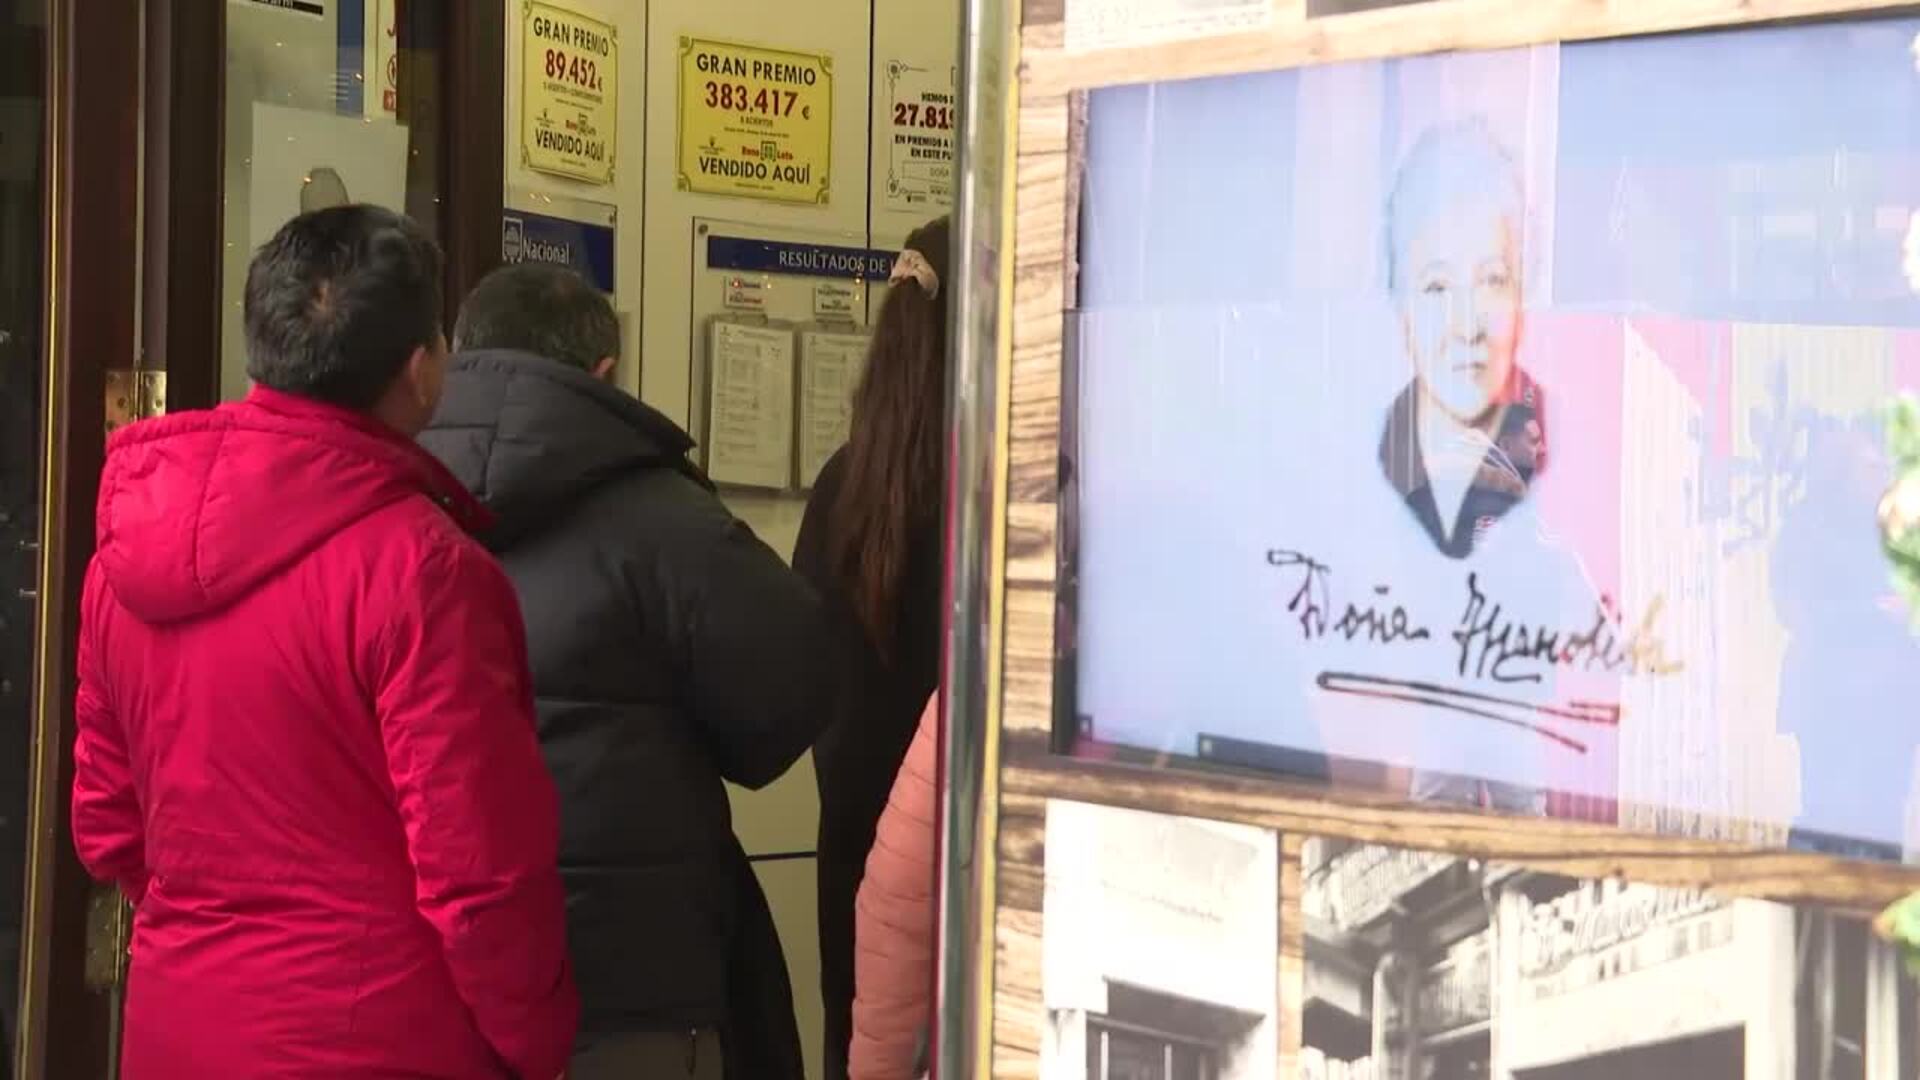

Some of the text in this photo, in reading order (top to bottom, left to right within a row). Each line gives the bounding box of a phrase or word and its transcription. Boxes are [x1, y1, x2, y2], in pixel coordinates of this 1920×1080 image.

[533, 16, 609, 57] GRAN PREMIO
[696, 53, 817, 86] GRAN PREMIO
[705, 80, 799, 118] 383.417
[535, 127, 583, 156] VENDIDO
[895, 133, 906, 145] EN
[907, 135, 942, 148] PREMIOS
[910, 147, 921, 159] EN
[922, 149, 941, 161] ESTE
[698, 155, 811, 185] VENDIDO AQUÍ
[523, 237, 570, 265] Nacional
[779, 250, 887, 273] RESULTADOS DE
